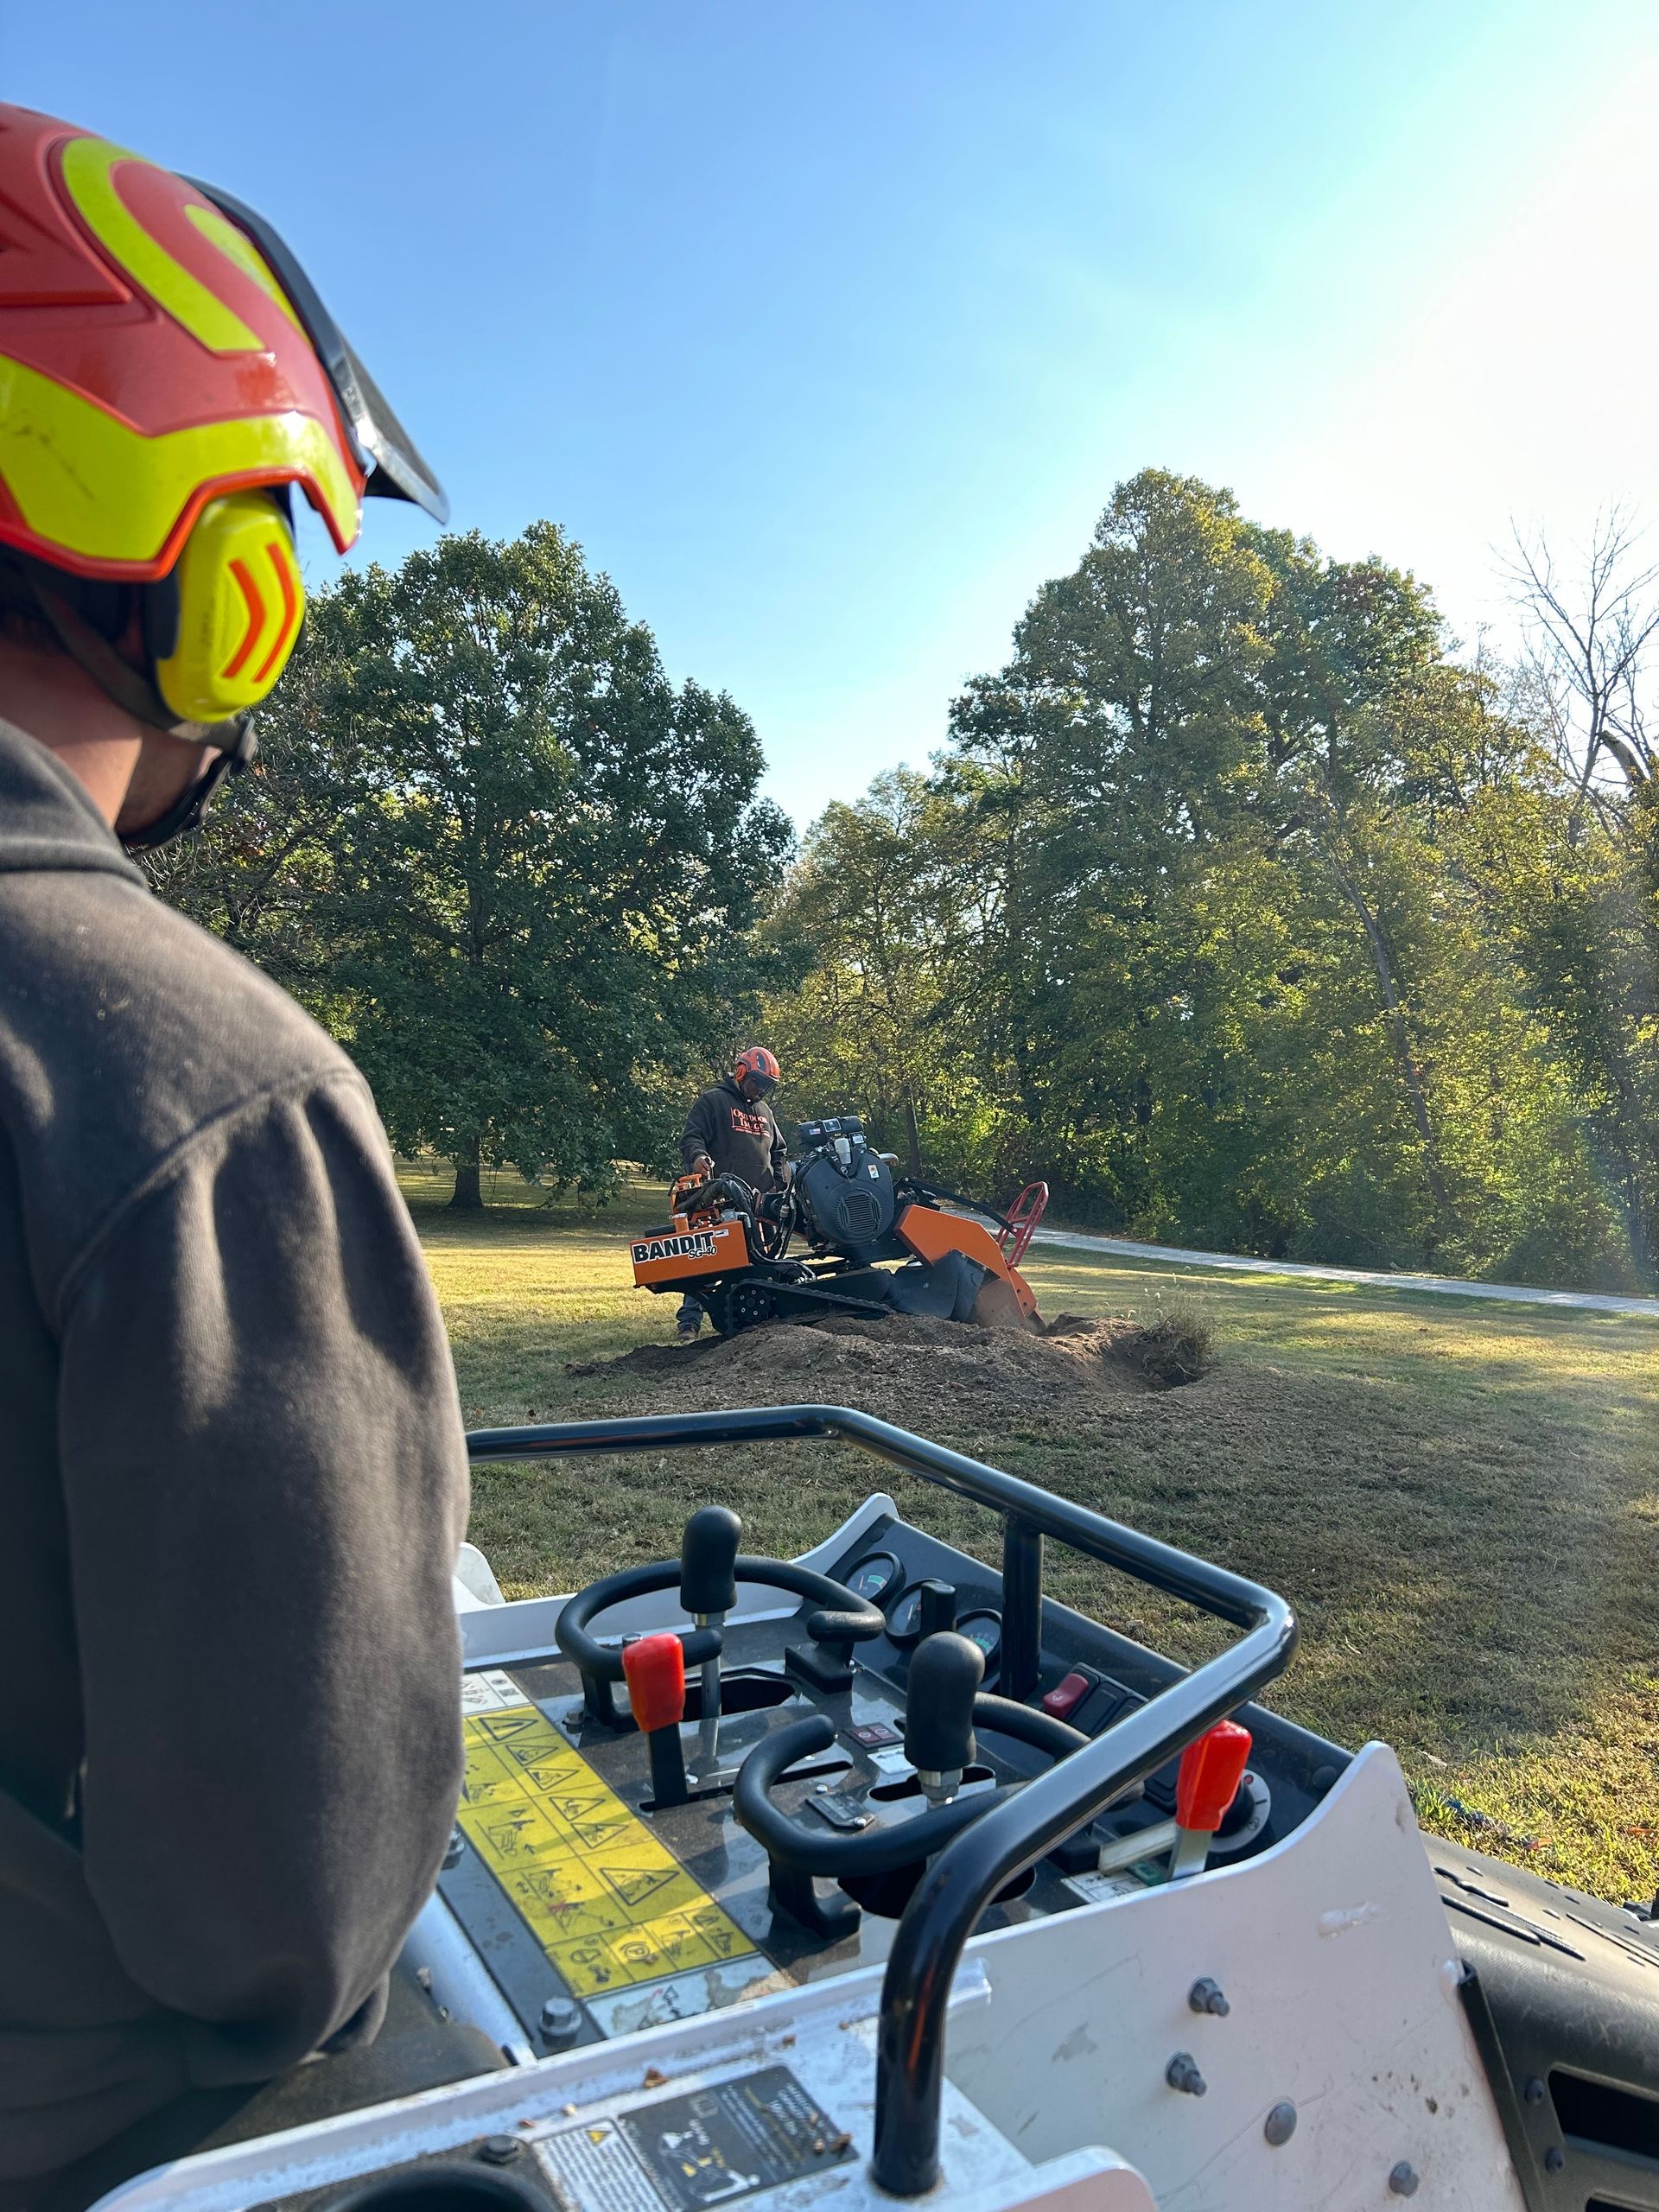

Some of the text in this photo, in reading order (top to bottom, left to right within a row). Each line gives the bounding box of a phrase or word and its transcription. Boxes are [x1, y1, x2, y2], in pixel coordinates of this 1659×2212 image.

[740, 1117, 764, 1130] IMGE
[632, 1230, 715, 1263] BANDIT
[689, 1246, 717, 1260] SG-40
